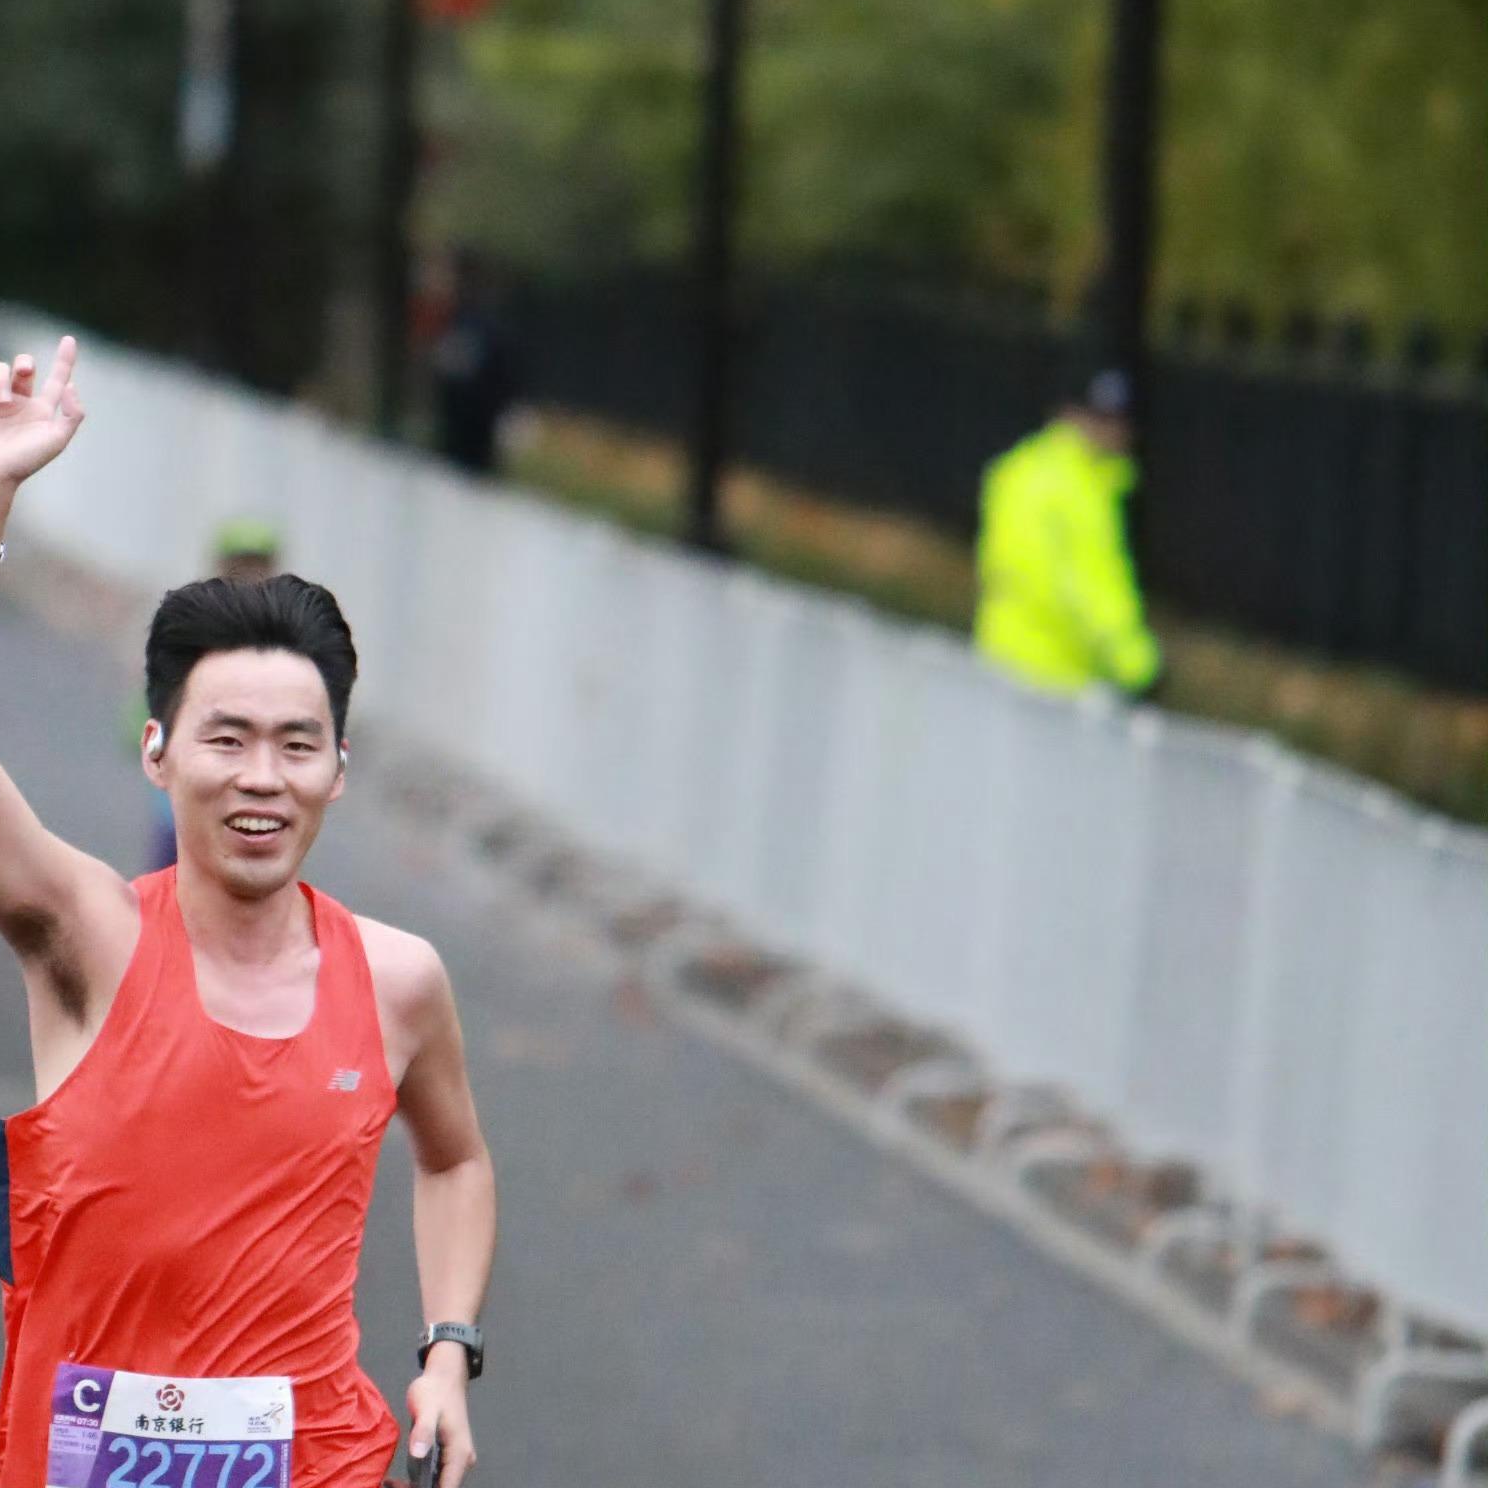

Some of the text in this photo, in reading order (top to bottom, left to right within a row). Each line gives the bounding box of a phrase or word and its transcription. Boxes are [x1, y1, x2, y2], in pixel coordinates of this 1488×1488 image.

[73, 1379, 101, 1412] C
[135, 1416, 205, 1434] 南京银行
